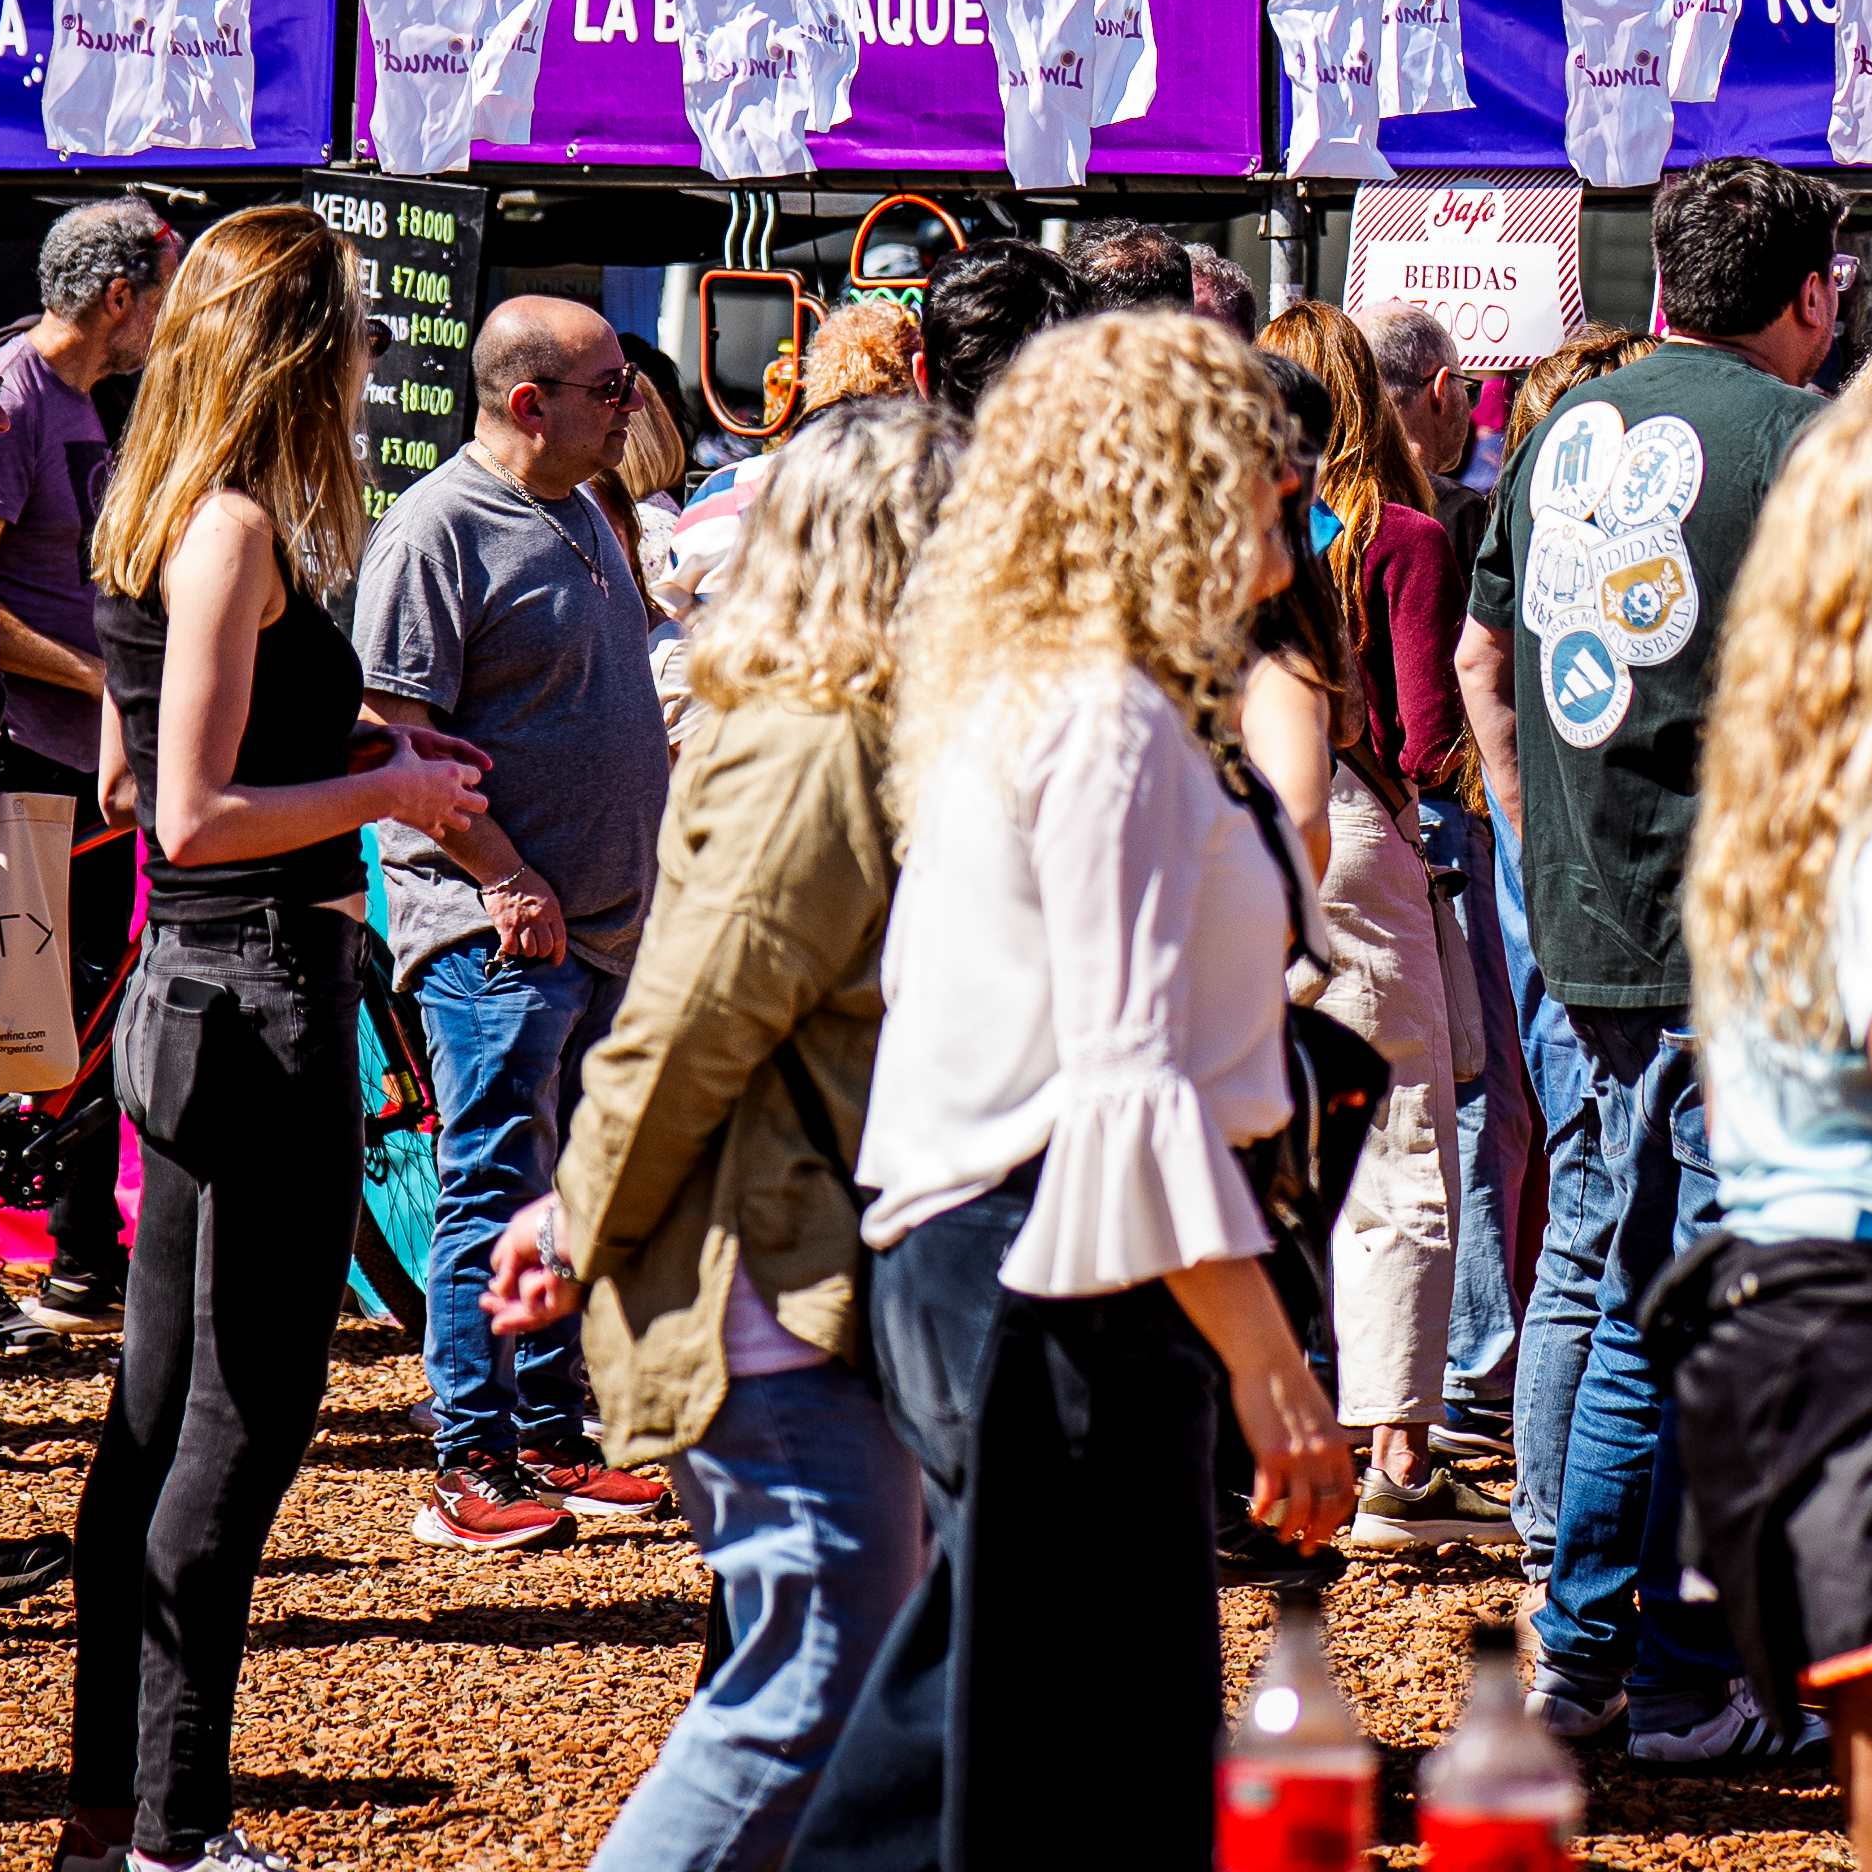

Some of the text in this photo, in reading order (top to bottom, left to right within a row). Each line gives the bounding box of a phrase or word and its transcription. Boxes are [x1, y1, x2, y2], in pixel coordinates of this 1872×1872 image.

[312, 191, 456, 245] KEBAB $8.000
[1434, 189, 1496, 235] Yafo
[1405, 264, 1517, 291] BEBIDAS
[410, 312, 468, 350] $9.000
[399, 378, 454, 416] $8.000
[1595, 529, 1678, 577] ADIDAS
[1606, 599, 1693, 658] FUSSBALL
